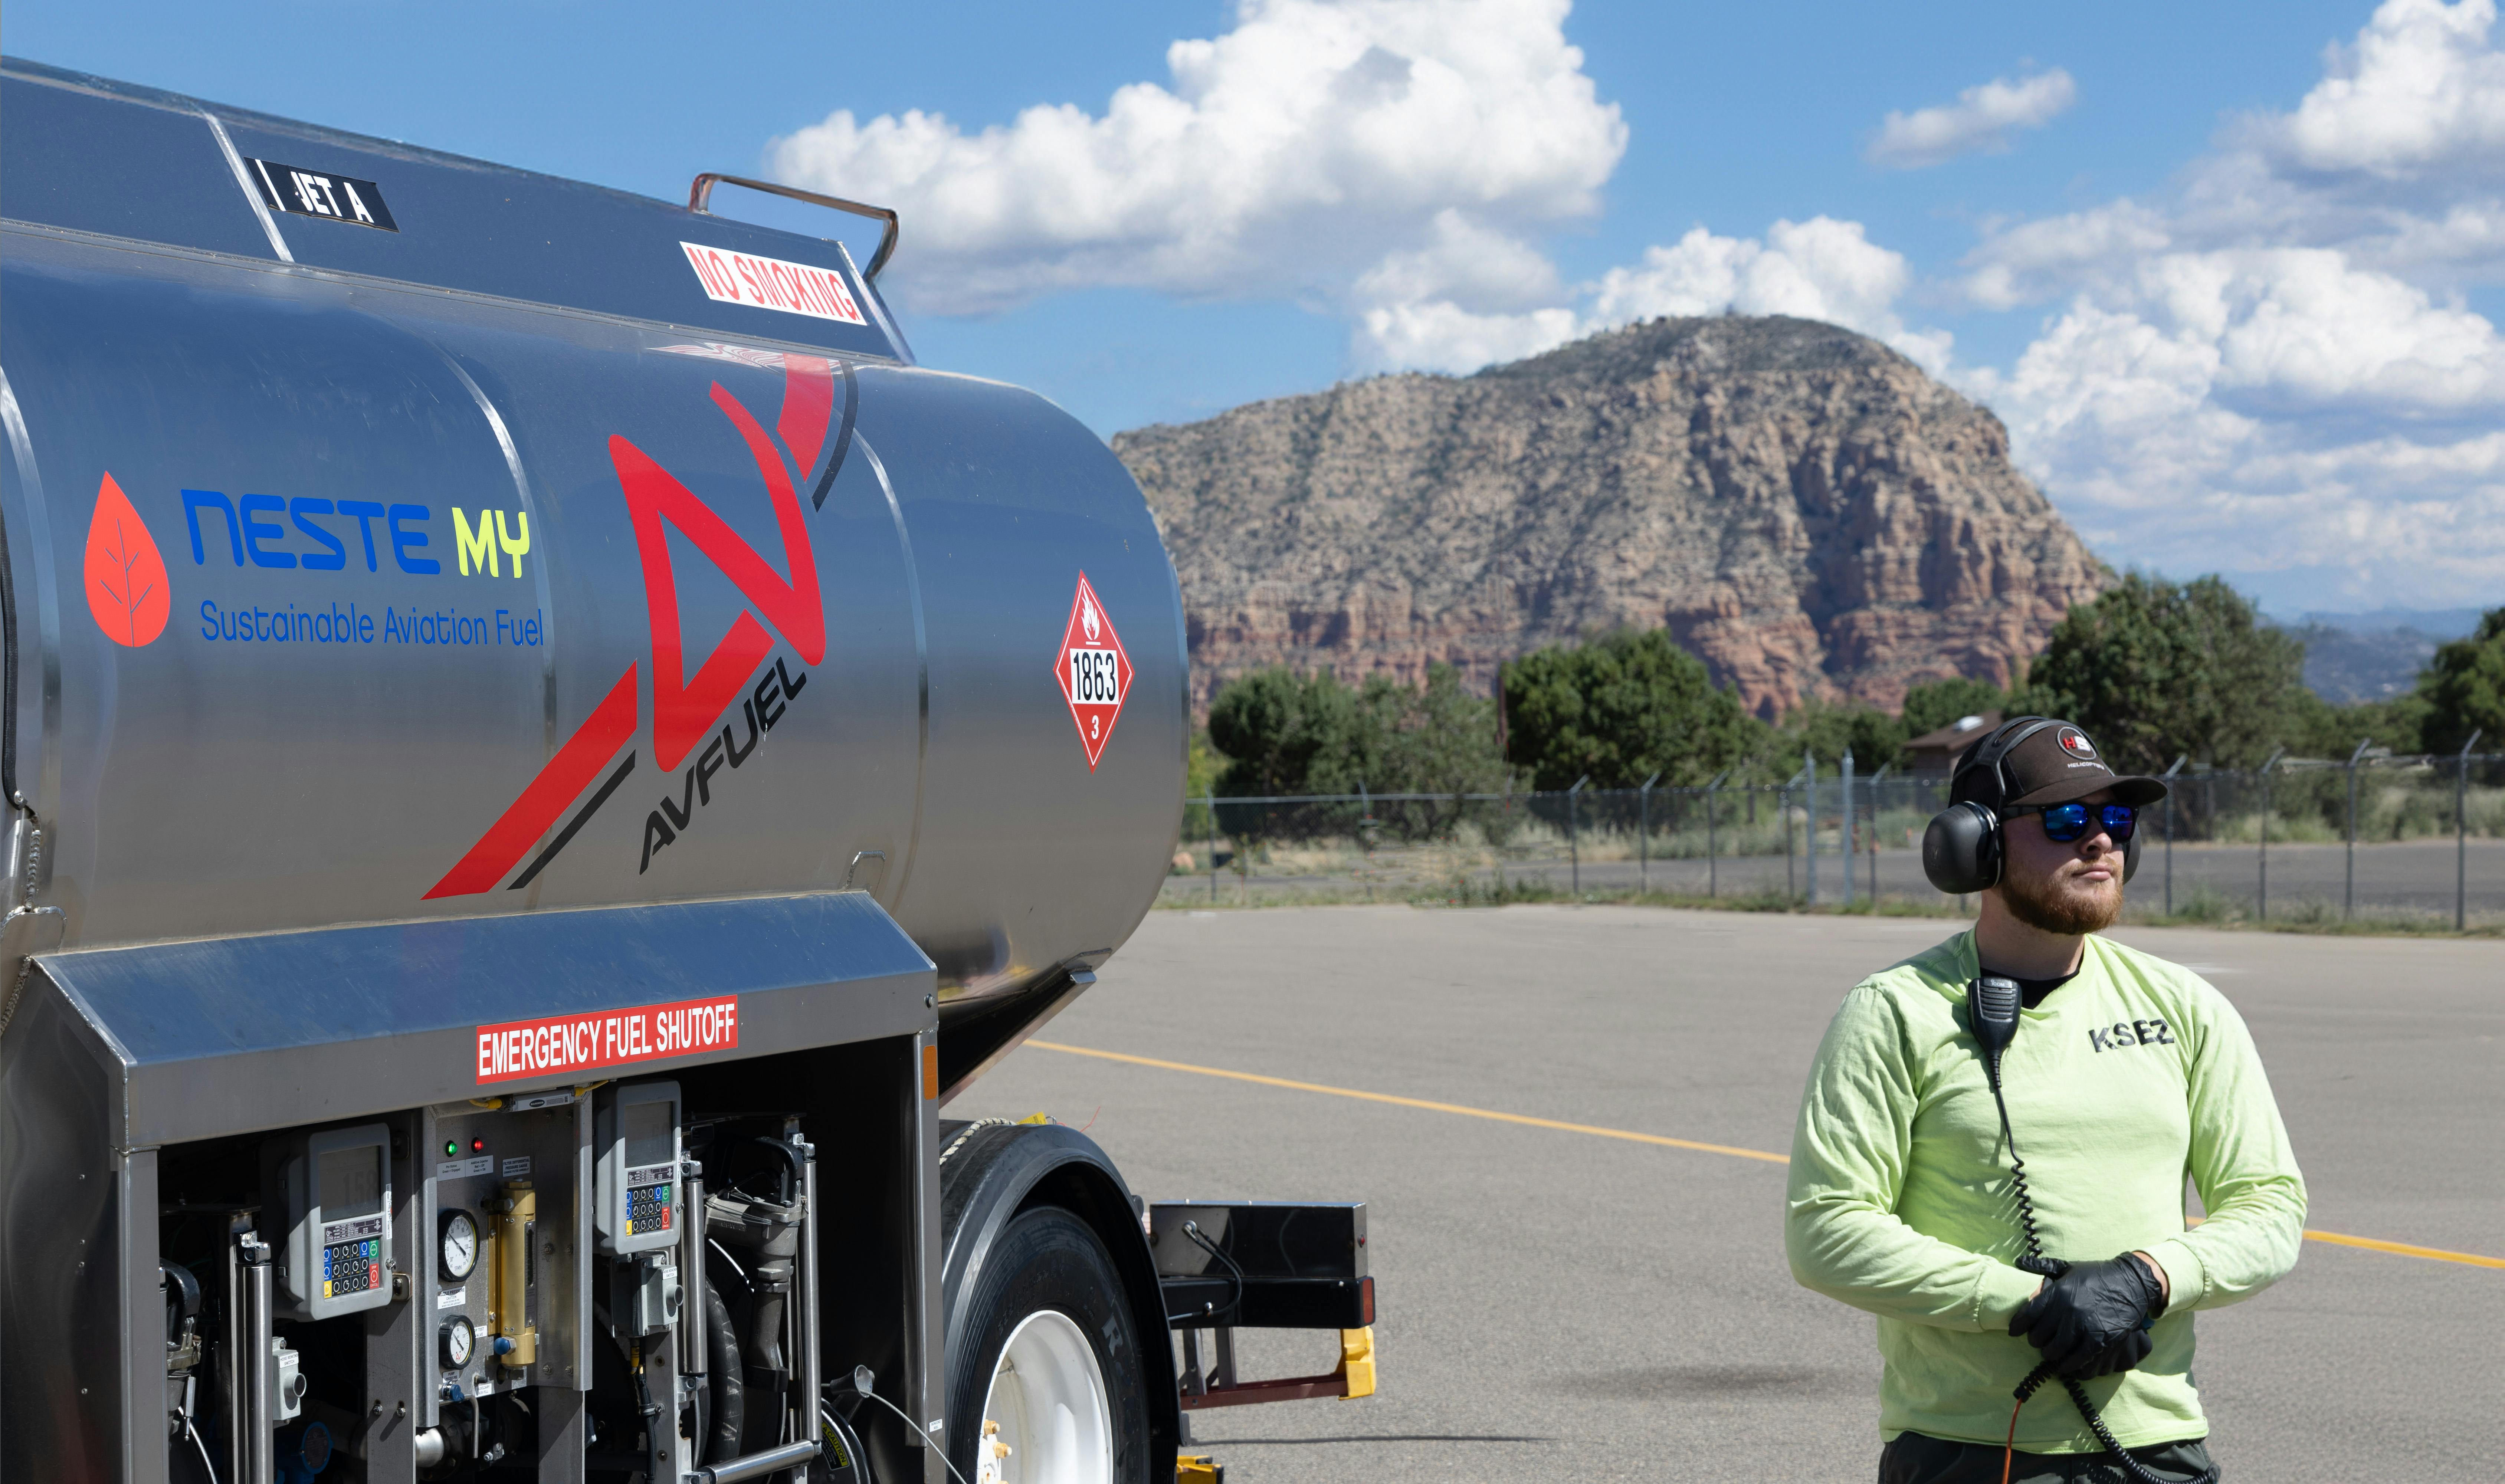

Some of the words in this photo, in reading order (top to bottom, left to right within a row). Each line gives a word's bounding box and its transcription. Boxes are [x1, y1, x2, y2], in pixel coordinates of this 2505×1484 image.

[290, 171, 342, 217] JET
[343, 182, 374, 223] A
[686, 247, 740, 300] NO
[733, 255, 860, 321] SMOKING
[180, 489, 441, 575] NESTE
[452, 507, 530, 578] MY
[200, 600, 375, 644] Sustainable
[384, 606, 488, 646] Aviation
[496, 608, 544, 646] Fuel
[1073, 651, 1116, 702] 1863
[1091, 715, 1099, 740] 3
[639, 656, 807, 876] AVFUEL
[479, 1020, 601, 1076] EMERGENCY
[606, 1014, 652, 1059] FUEL
[656, 1003, 735, 1052] SHUTOFF
[2088, 1018, 2175, 1053] KSEZ
[827, 1431, 846, 1463] CAUTION
